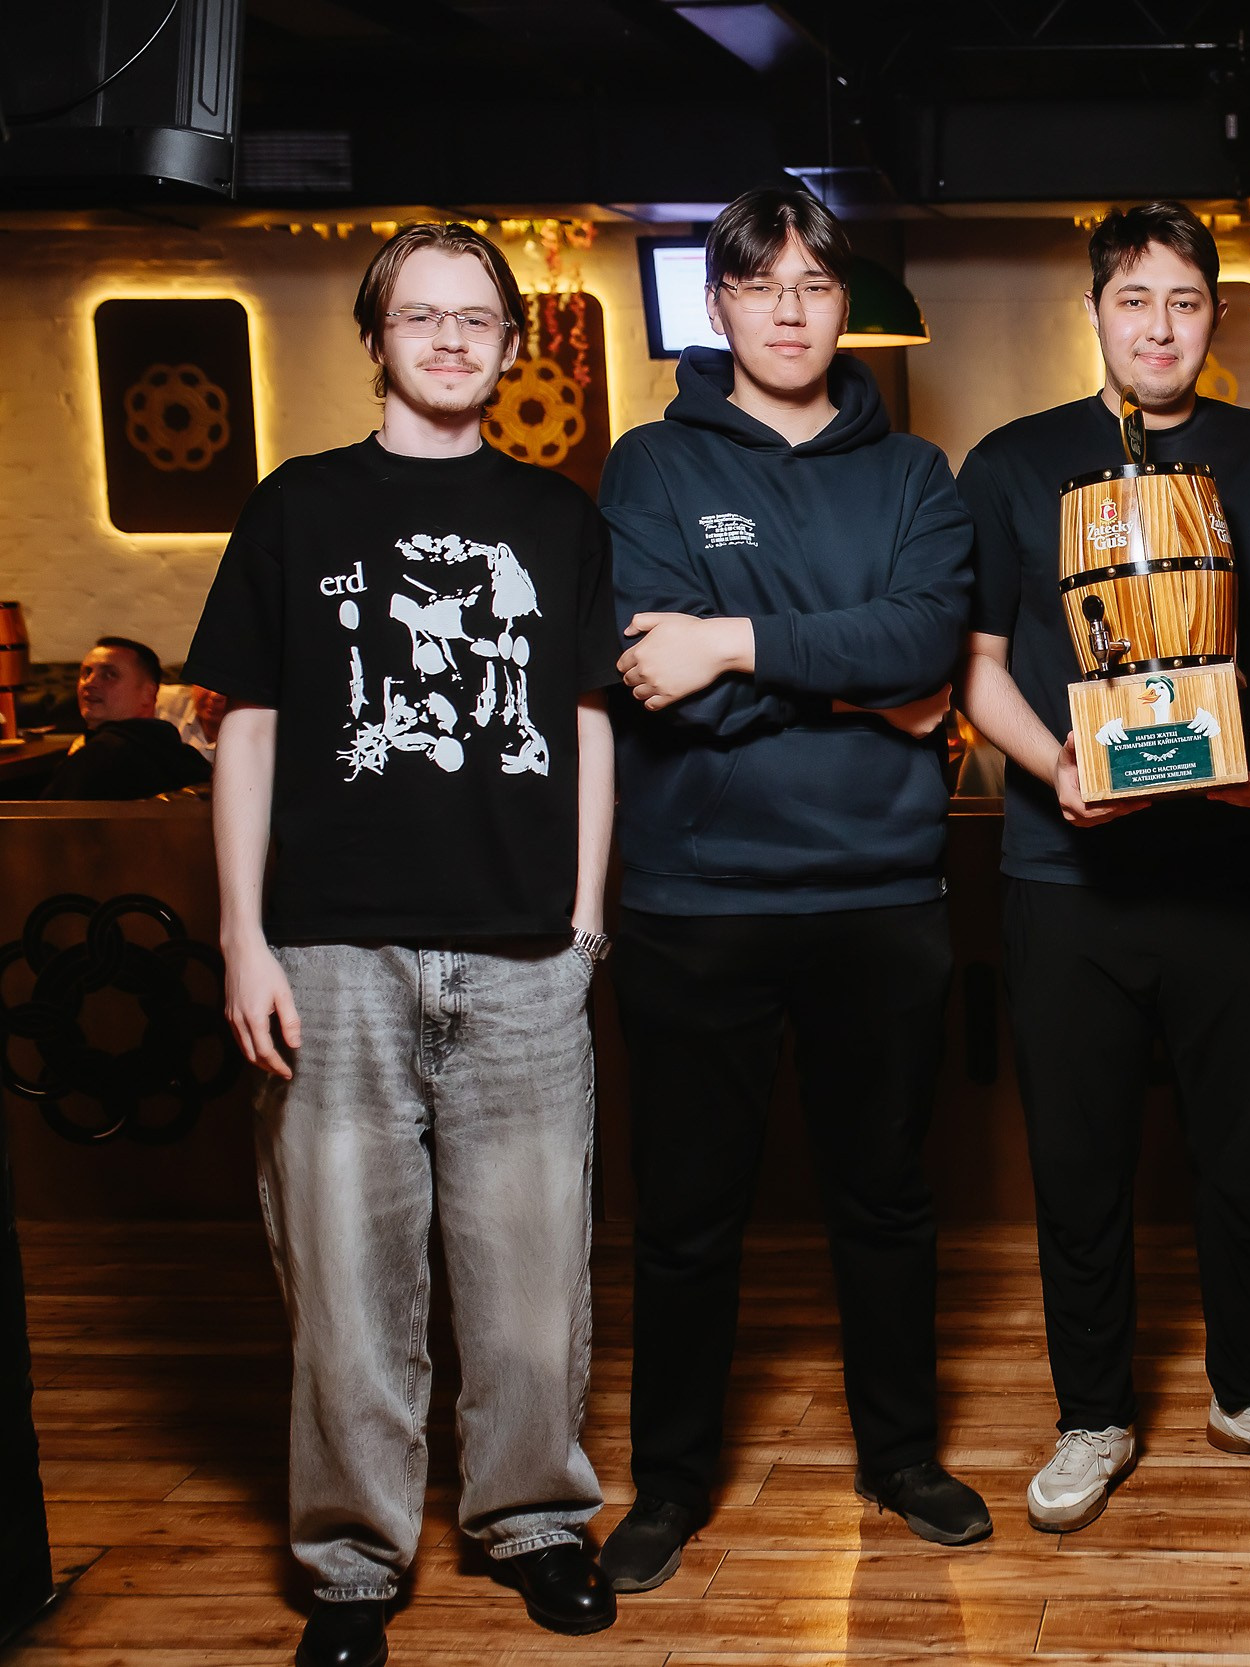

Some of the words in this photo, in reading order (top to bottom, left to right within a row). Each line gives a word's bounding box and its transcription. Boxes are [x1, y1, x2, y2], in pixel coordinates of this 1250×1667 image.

[1086, 520, 1134, 541] Žatecký
[1094, 534, 1128, 551] Gus
[320, 560, 368, 596] erd
[1156, 731, 1178, 740] ЖАТЕЦ
[1124, 768, 1152, 777] СВАРЕНО
[1157, 762, 1197, 773] НАСТОЯЩИМ
[1131, 773, 1166, 783] ЖАТЕЦКИМ
[1166, 769, 1192, 778] ХМЕЛЕМ
